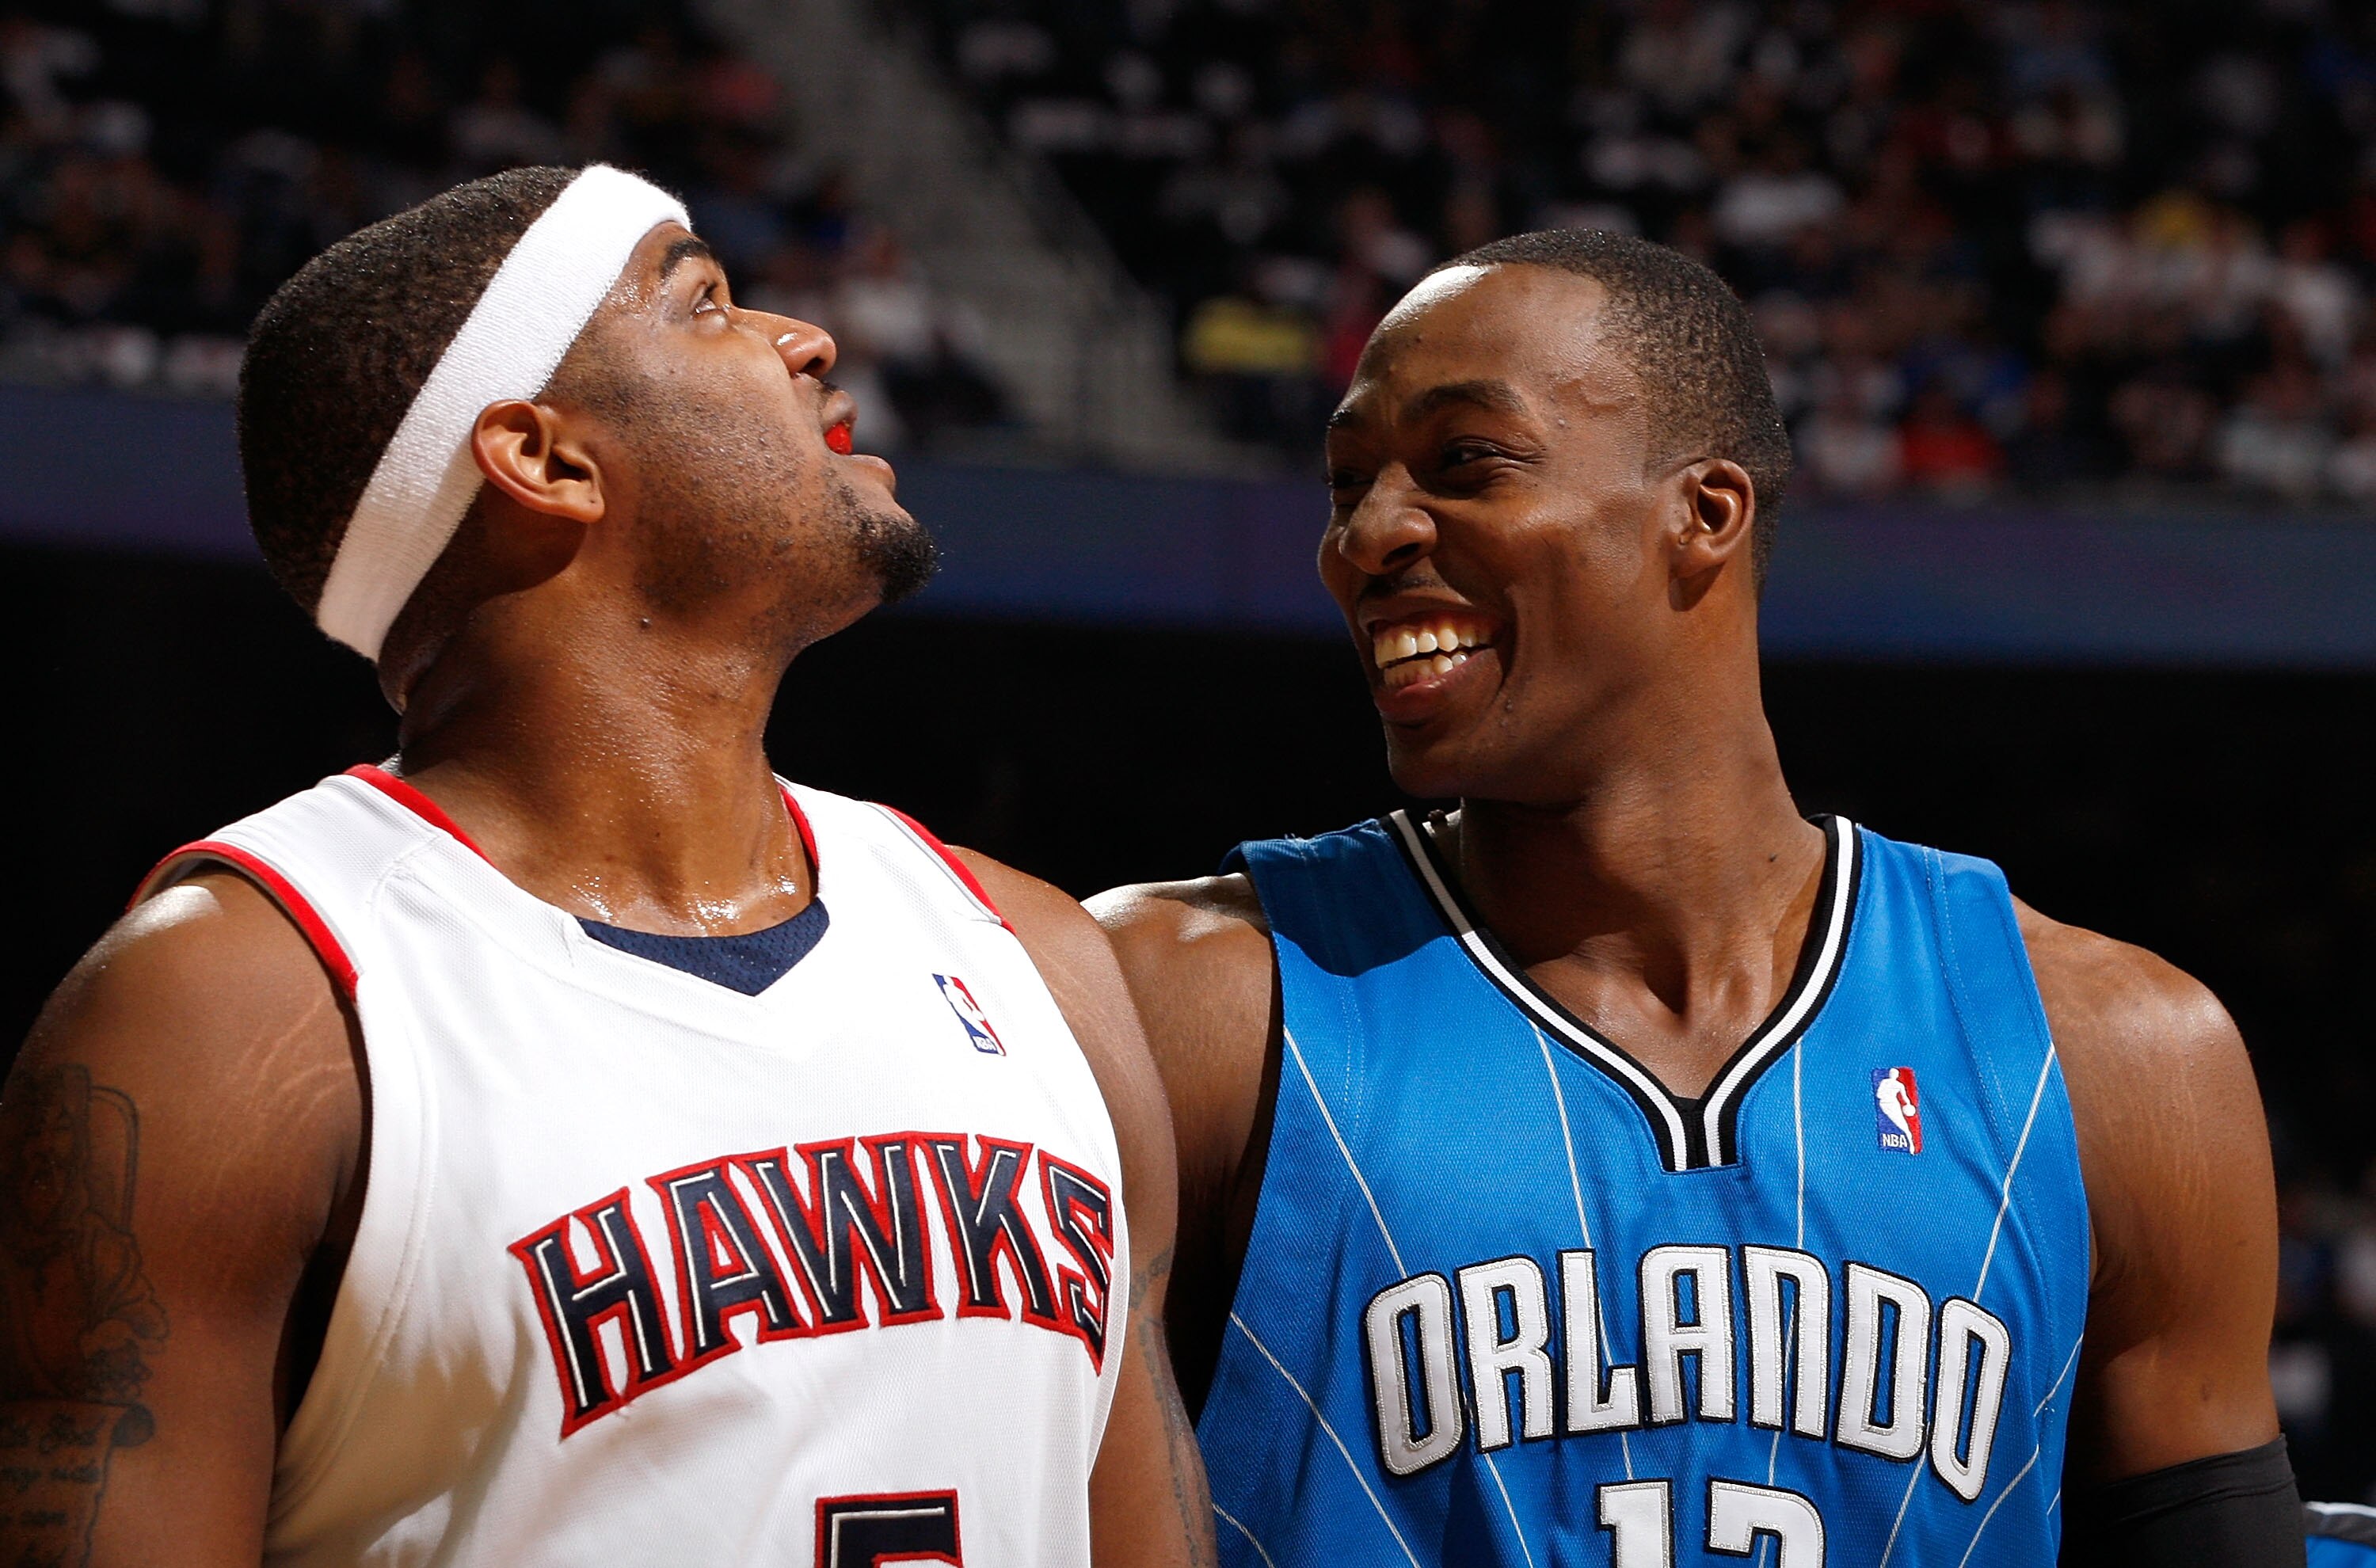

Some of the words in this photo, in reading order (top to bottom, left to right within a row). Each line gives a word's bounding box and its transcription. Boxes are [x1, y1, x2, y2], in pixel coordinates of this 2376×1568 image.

[1882, 1133, 1908, 1147] NBA
[507, 1131, 1114, 1440] HAWKS
[1365, 1243, 2012, 1502] ORLANDO
